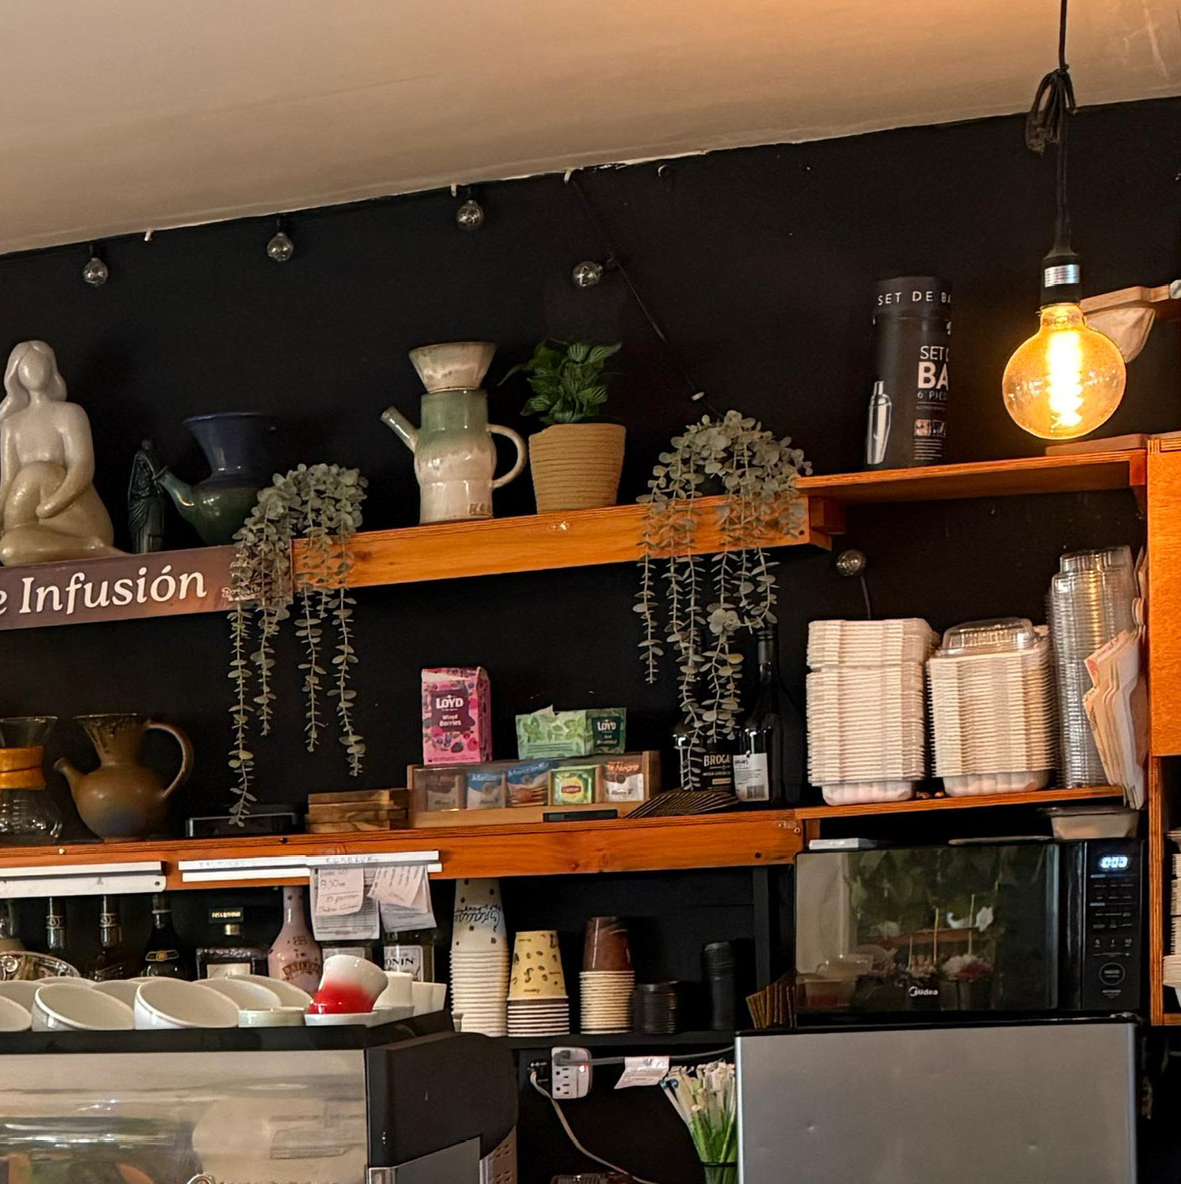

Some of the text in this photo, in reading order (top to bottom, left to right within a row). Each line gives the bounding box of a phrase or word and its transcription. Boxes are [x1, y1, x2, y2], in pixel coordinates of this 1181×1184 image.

[877, 292, 902, 306] SET
[912, 291, 934, 303] DE
[920, 345, 944, 361] SET
[18, 565, 208, 616] Infusión
[435, 695, 464, 710] LOYD
